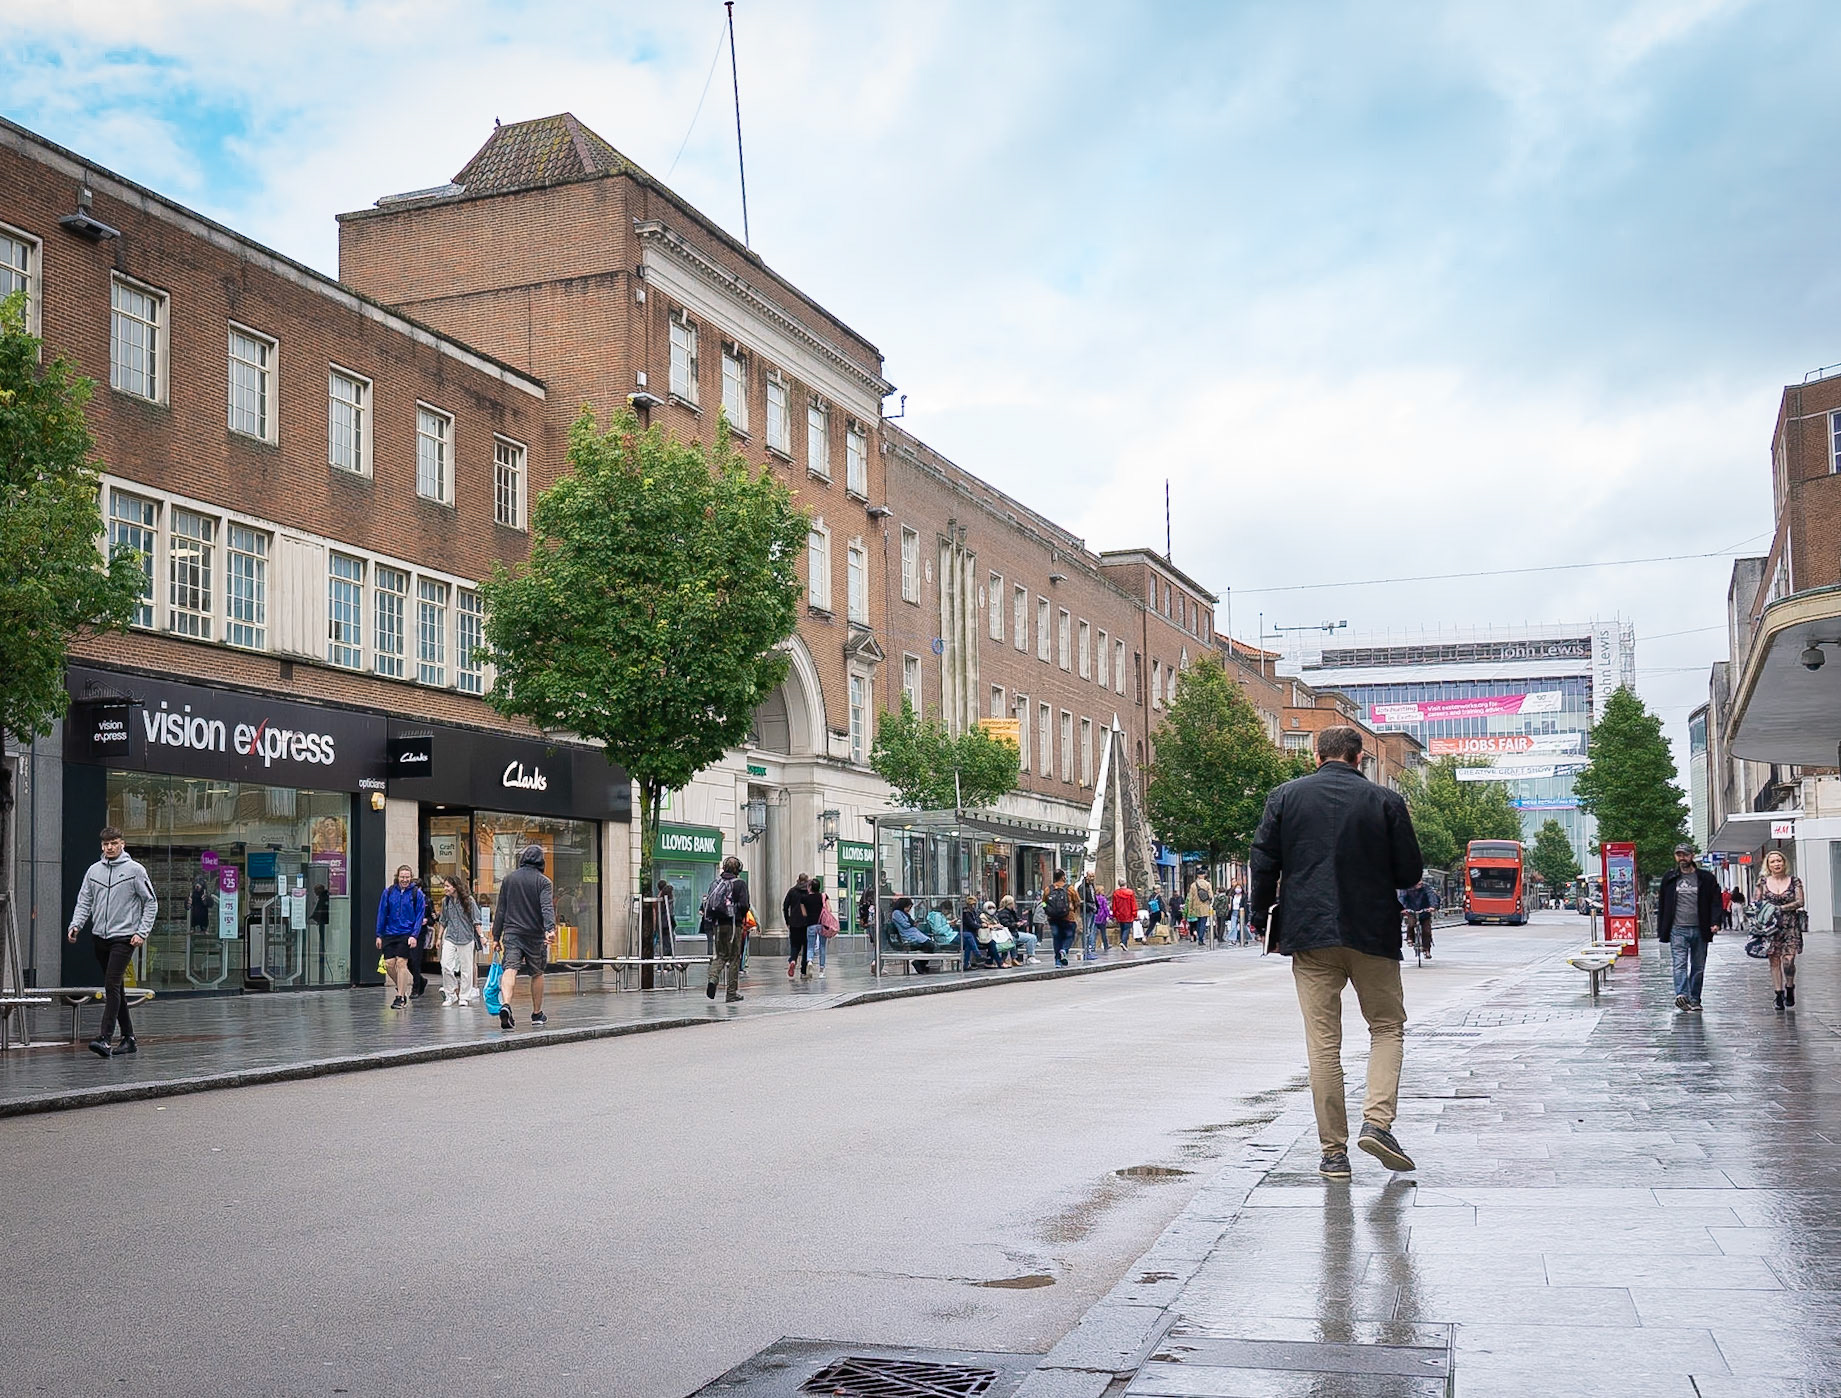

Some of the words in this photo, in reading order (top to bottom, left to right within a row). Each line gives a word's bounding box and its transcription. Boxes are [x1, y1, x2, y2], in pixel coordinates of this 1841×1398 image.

[1500, 642, 1535, 660] John
[1541, 642, 1584, 657] Lewis
[1597, 630, 1611, 666] Lewis
[98, 719, 123, 731] vision
[93, 731, 128, 743] express
[142, 701, 226, 752] vision
[234, 717, 336, 768] express
[1463, 738, 1496, 752] JOBS
[1498, 737, 1528, 751] FAIR
[399, 752, 428, 763] Clarks
[502, 760, 548, 791] Clarks
[1527, 766, 1552, 774] SHOW
[358, 777, 386, 790] opticians
[661, 833, 693, 852] LLOYDS
[693, 836, 717, 853] BANK
[842, 845, 864, 861] LLOYDS
[863, 848, 875, 862] BAN
